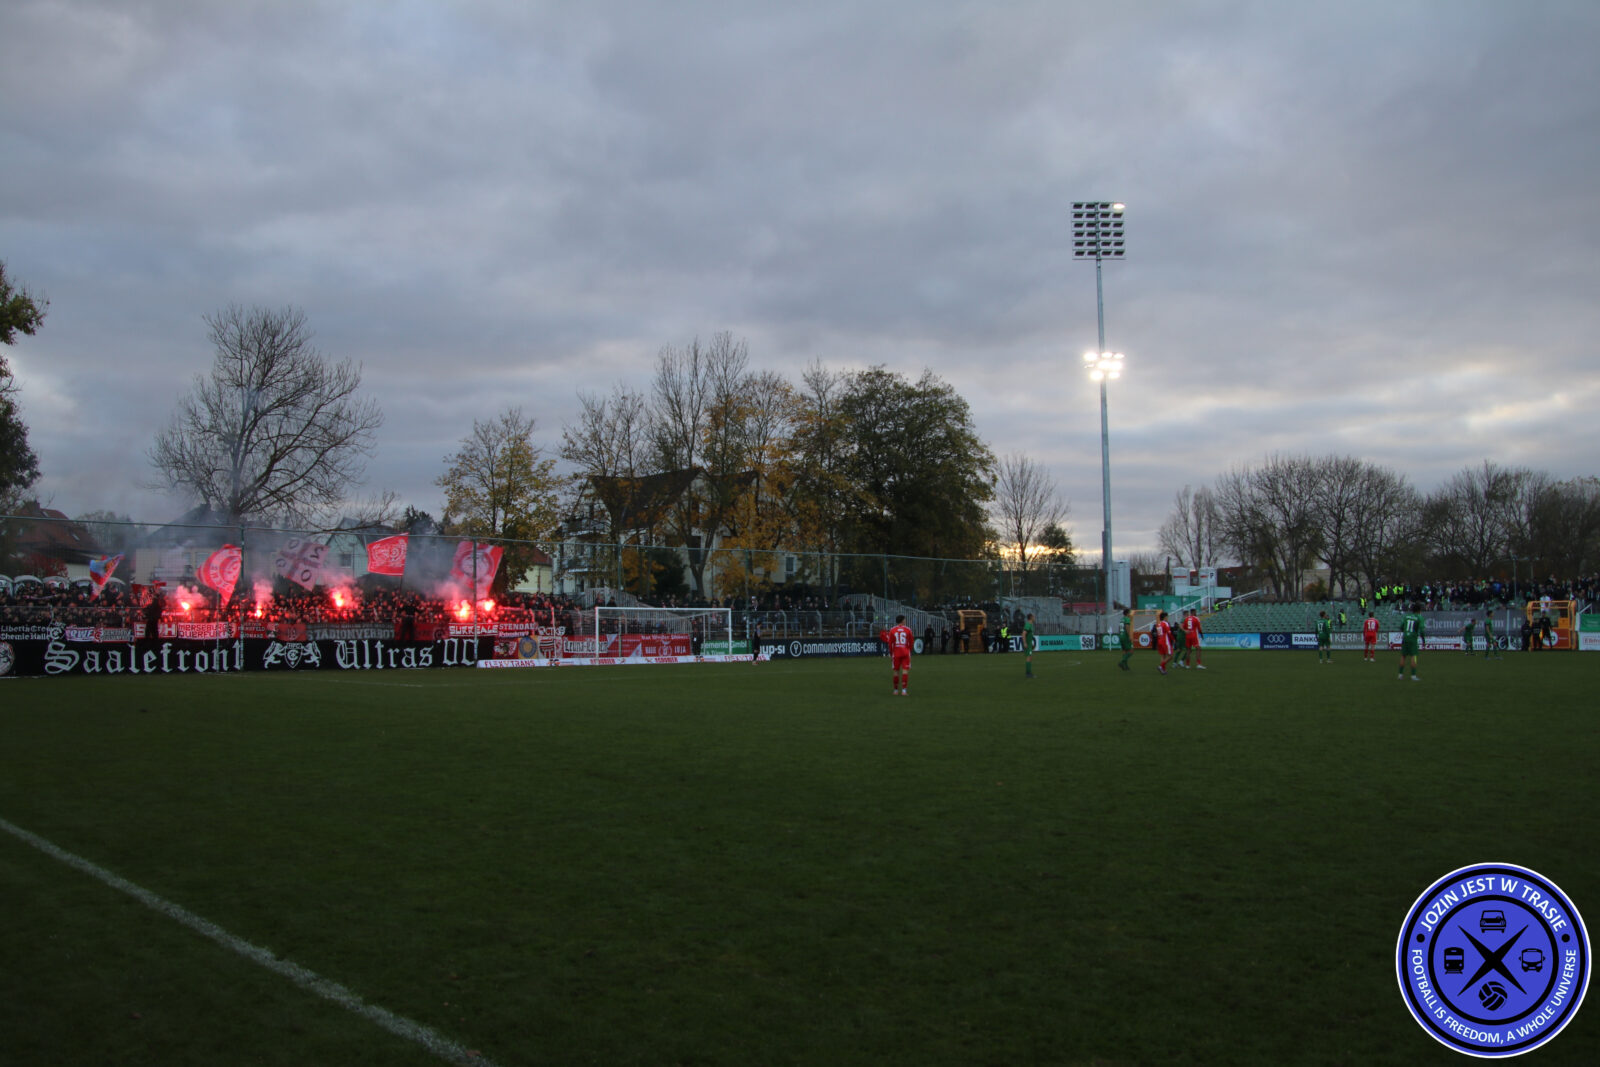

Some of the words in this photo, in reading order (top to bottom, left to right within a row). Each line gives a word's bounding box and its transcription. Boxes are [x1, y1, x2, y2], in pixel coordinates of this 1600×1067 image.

[334, 639, 434, 670] Ultras
[894, 633, 907, 645] 16
[45, 639, 242, 674] Saalefront
